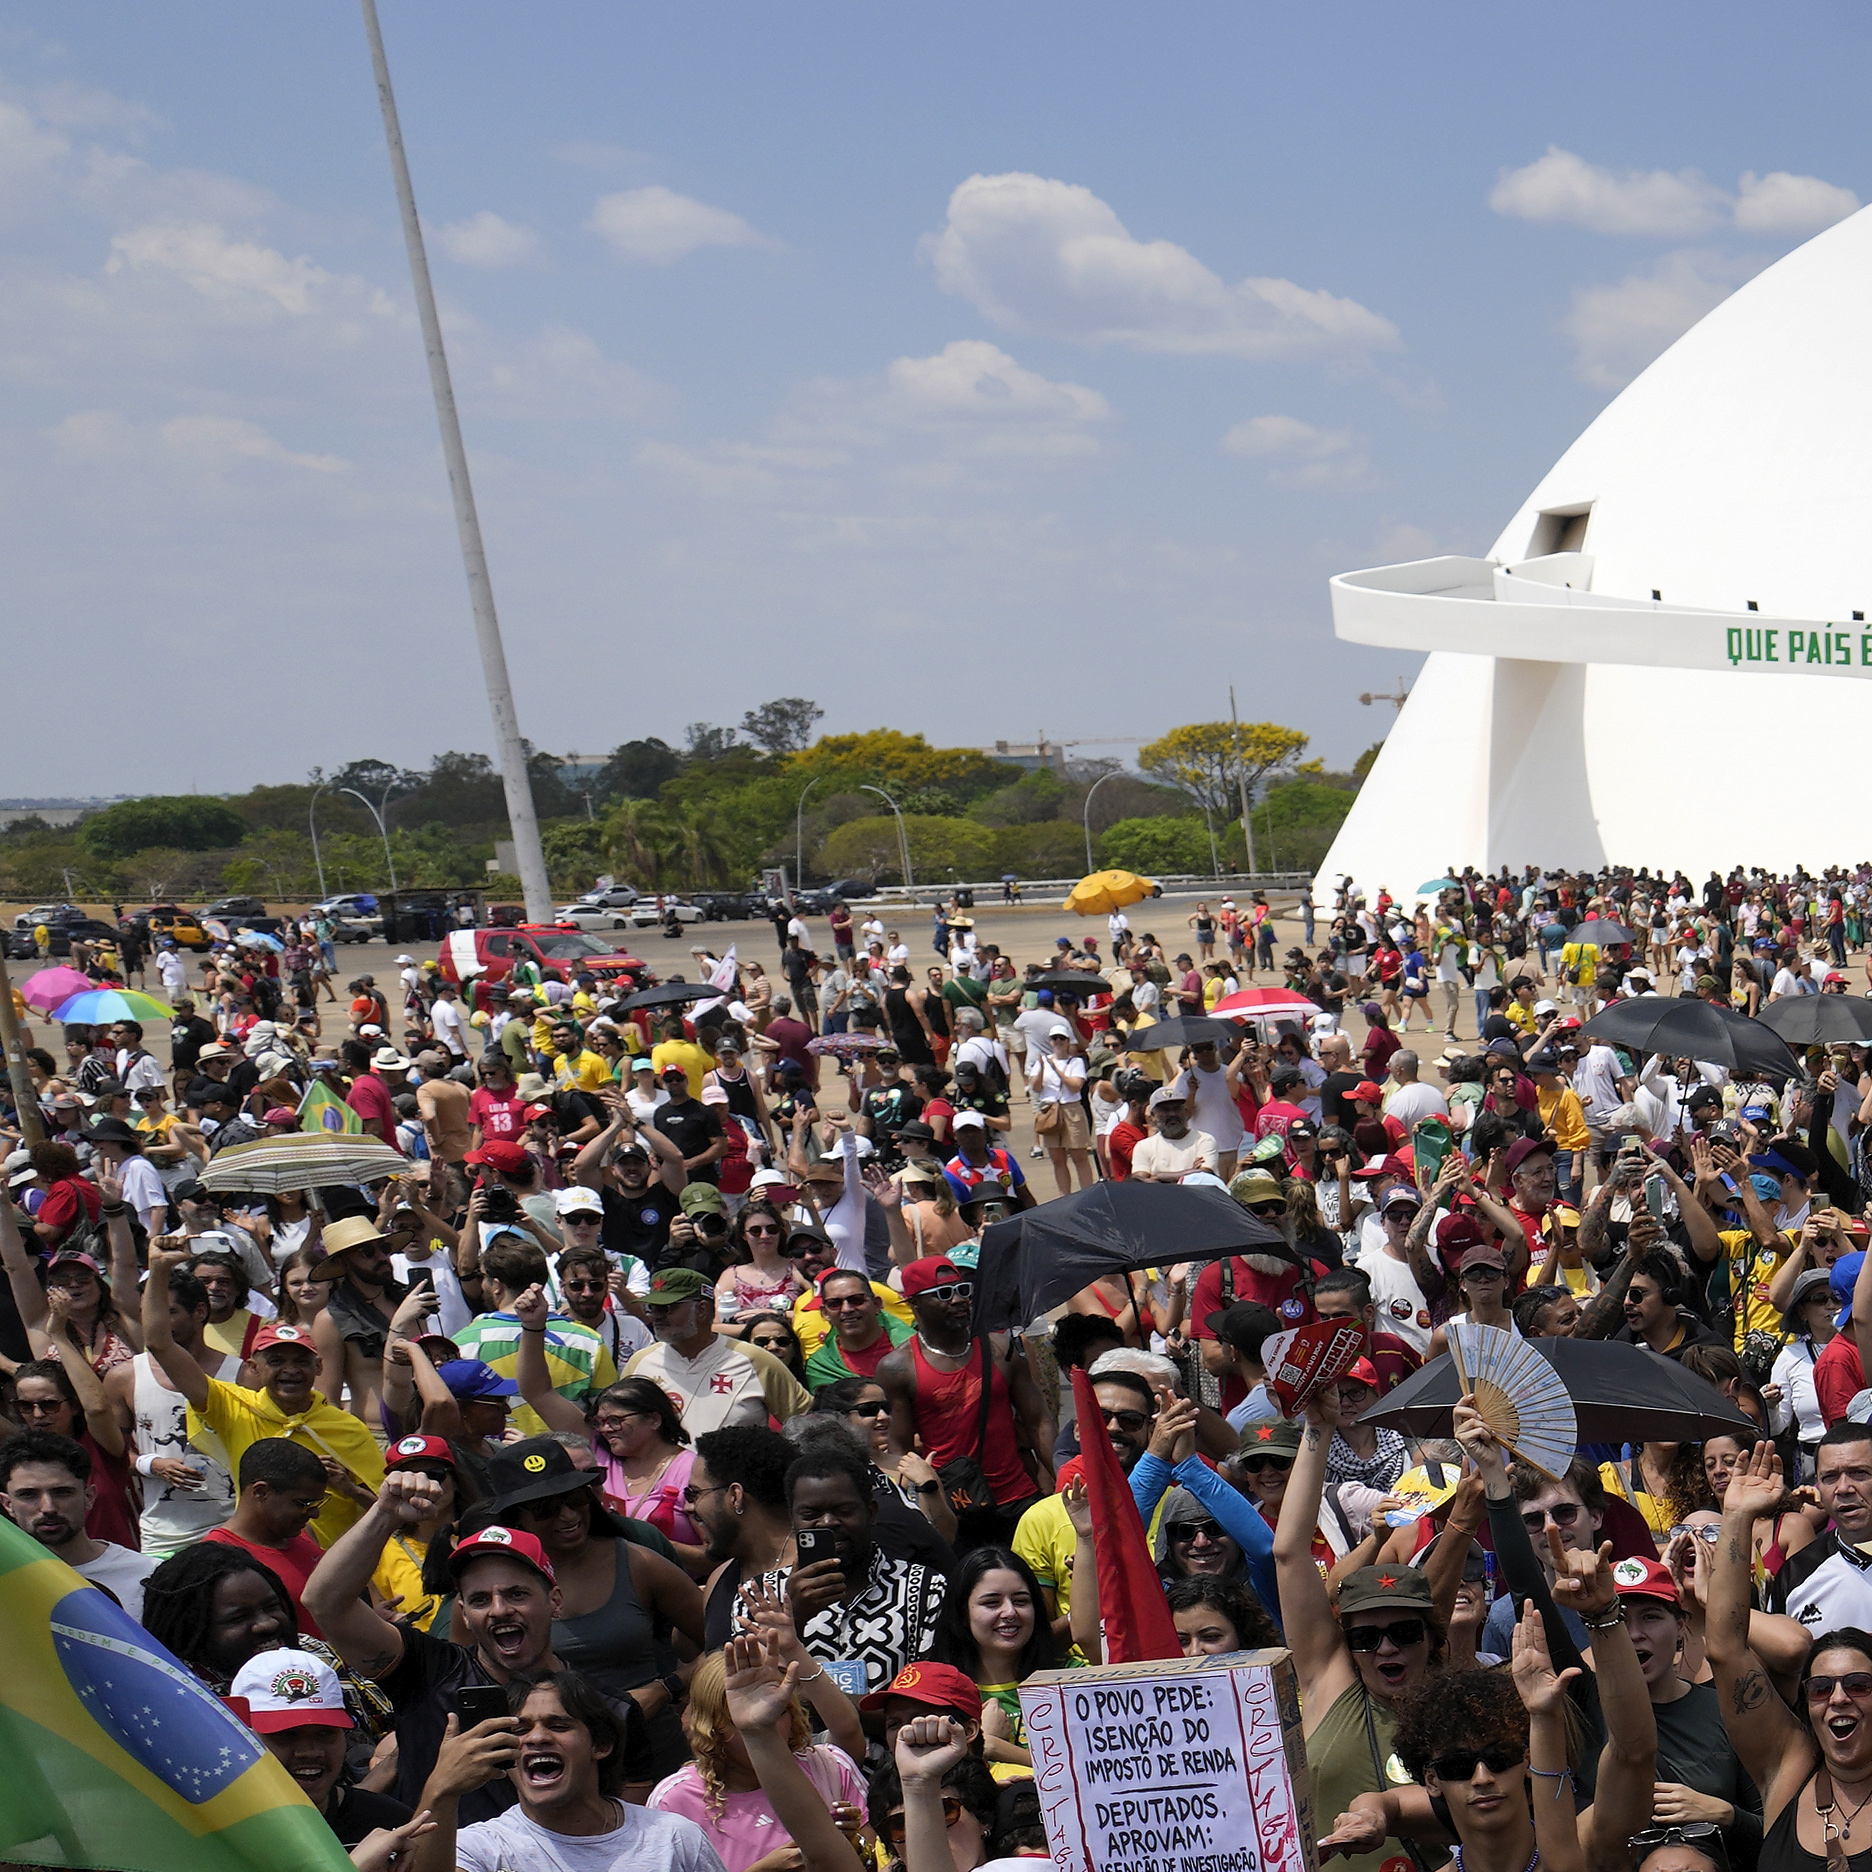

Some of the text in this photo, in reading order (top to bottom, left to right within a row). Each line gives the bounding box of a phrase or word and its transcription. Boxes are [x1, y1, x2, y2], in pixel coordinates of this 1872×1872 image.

[1727, 628, 1779, 666] QUE
[1788, 622, 1851, 666] PAÍS
[489, 1102, 510, 1113] LULA
[490, 1112, 512, 1132] 13
[54, 1624, 116, 1650] ORDEM
[153, 1656, 266, 1754] PROGRESSO
[1076, 1684, 1214, 1720] O POVO PEDE:
[1084, 1716, 1210, 1757] ISENÇÃO DO
[1085, 1747, 1237, 1788] IMPOSTO DE RENDA
[1108, 1826, 1213, 1860] APROVAM:
